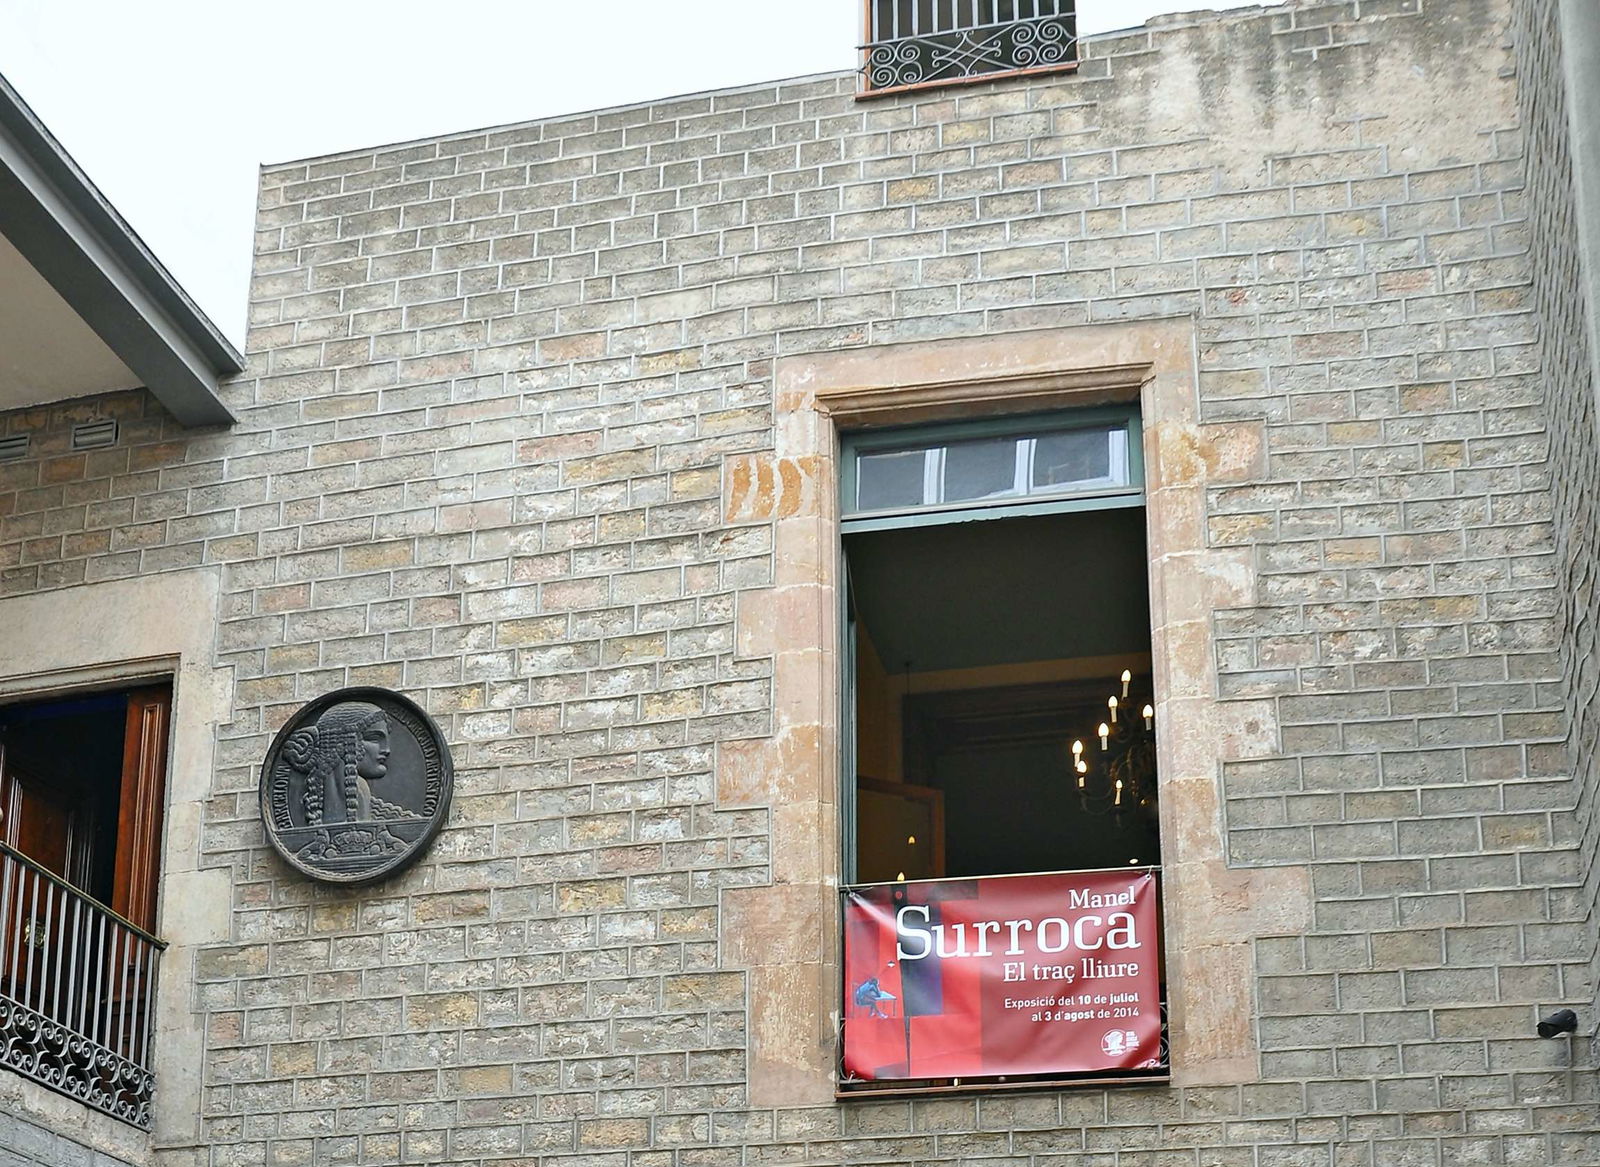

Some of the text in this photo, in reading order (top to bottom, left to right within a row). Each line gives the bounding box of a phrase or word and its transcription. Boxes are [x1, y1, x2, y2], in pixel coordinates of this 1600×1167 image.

[1068, 886, 1137, 910] Manel
[896, 904, 1142, 961] Surroca
[1002, 958, 1139, 984] El traç lliure
[1004, 992, 1140, 1010] Exposició del 10 de juliol
[1031, 1007, 1140, 1022] al 3 d'agost de 2014
